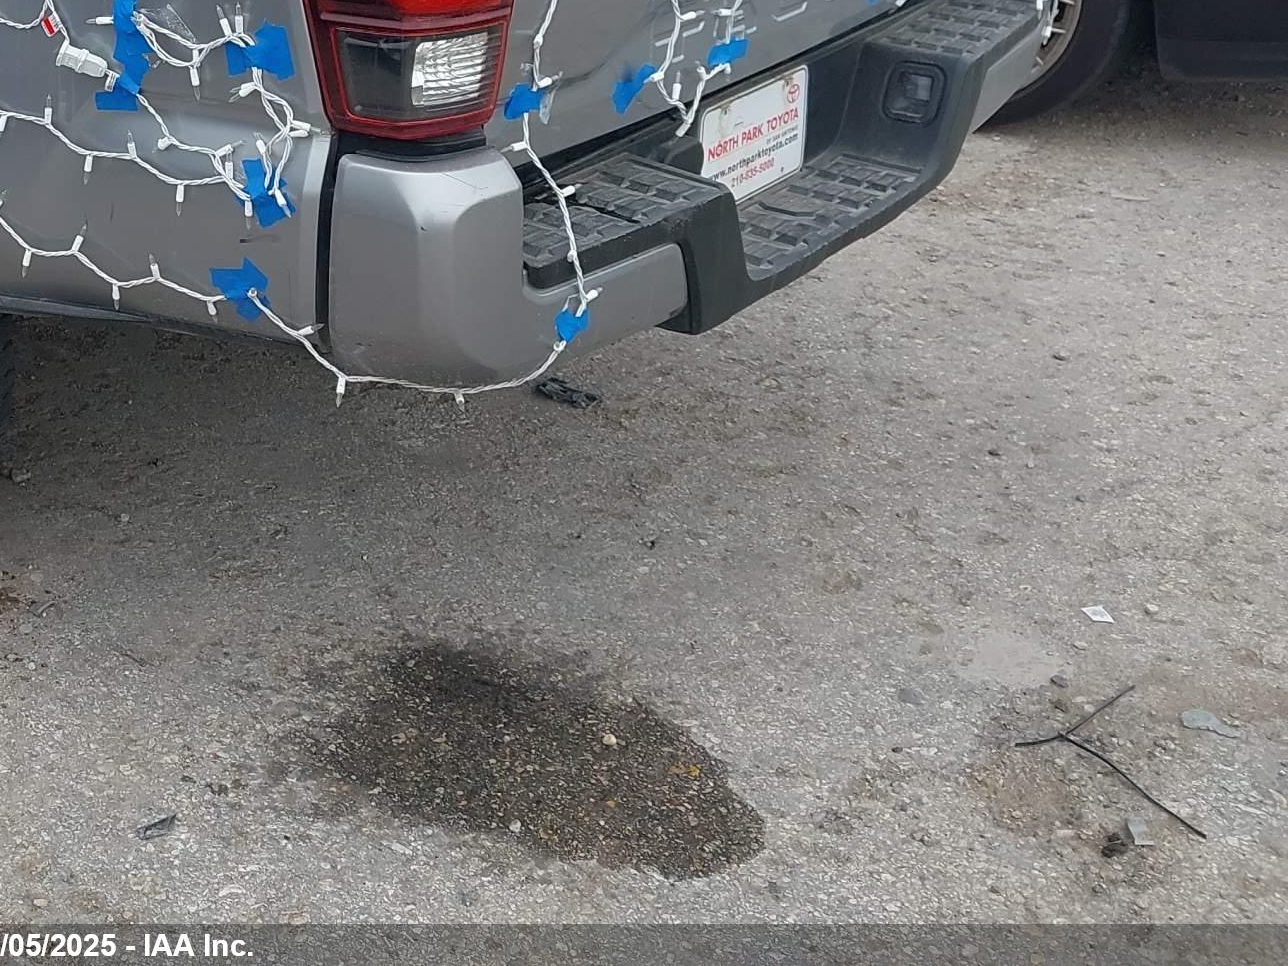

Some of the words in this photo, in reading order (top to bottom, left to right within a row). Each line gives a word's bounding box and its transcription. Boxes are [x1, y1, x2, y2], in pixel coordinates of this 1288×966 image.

[708, 135, 738, 161] NORTH
[742, 123, 763, 144] PARK
[767, 107, 798, 132] TOYOTA
